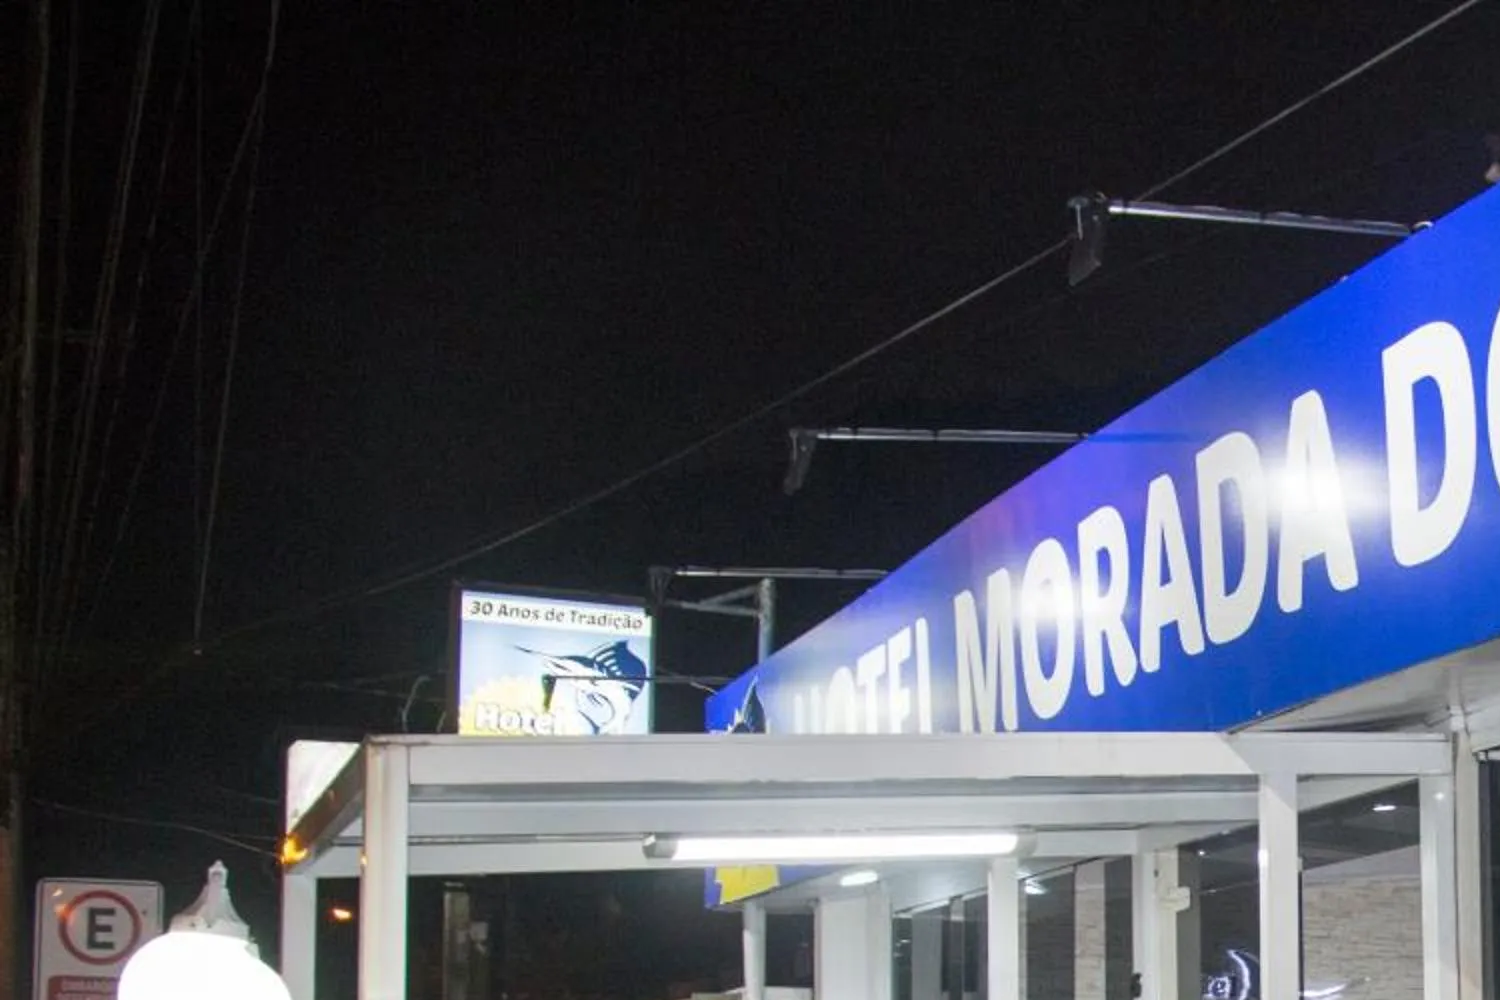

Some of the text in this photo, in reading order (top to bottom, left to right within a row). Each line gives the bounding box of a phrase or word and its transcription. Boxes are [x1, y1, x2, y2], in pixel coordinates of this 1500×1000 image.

[953, 388, 1359, 735] MORADA
[470, 600, 644, 630] 30 Anos de Tradição
[86, 907, 117, 950] E
